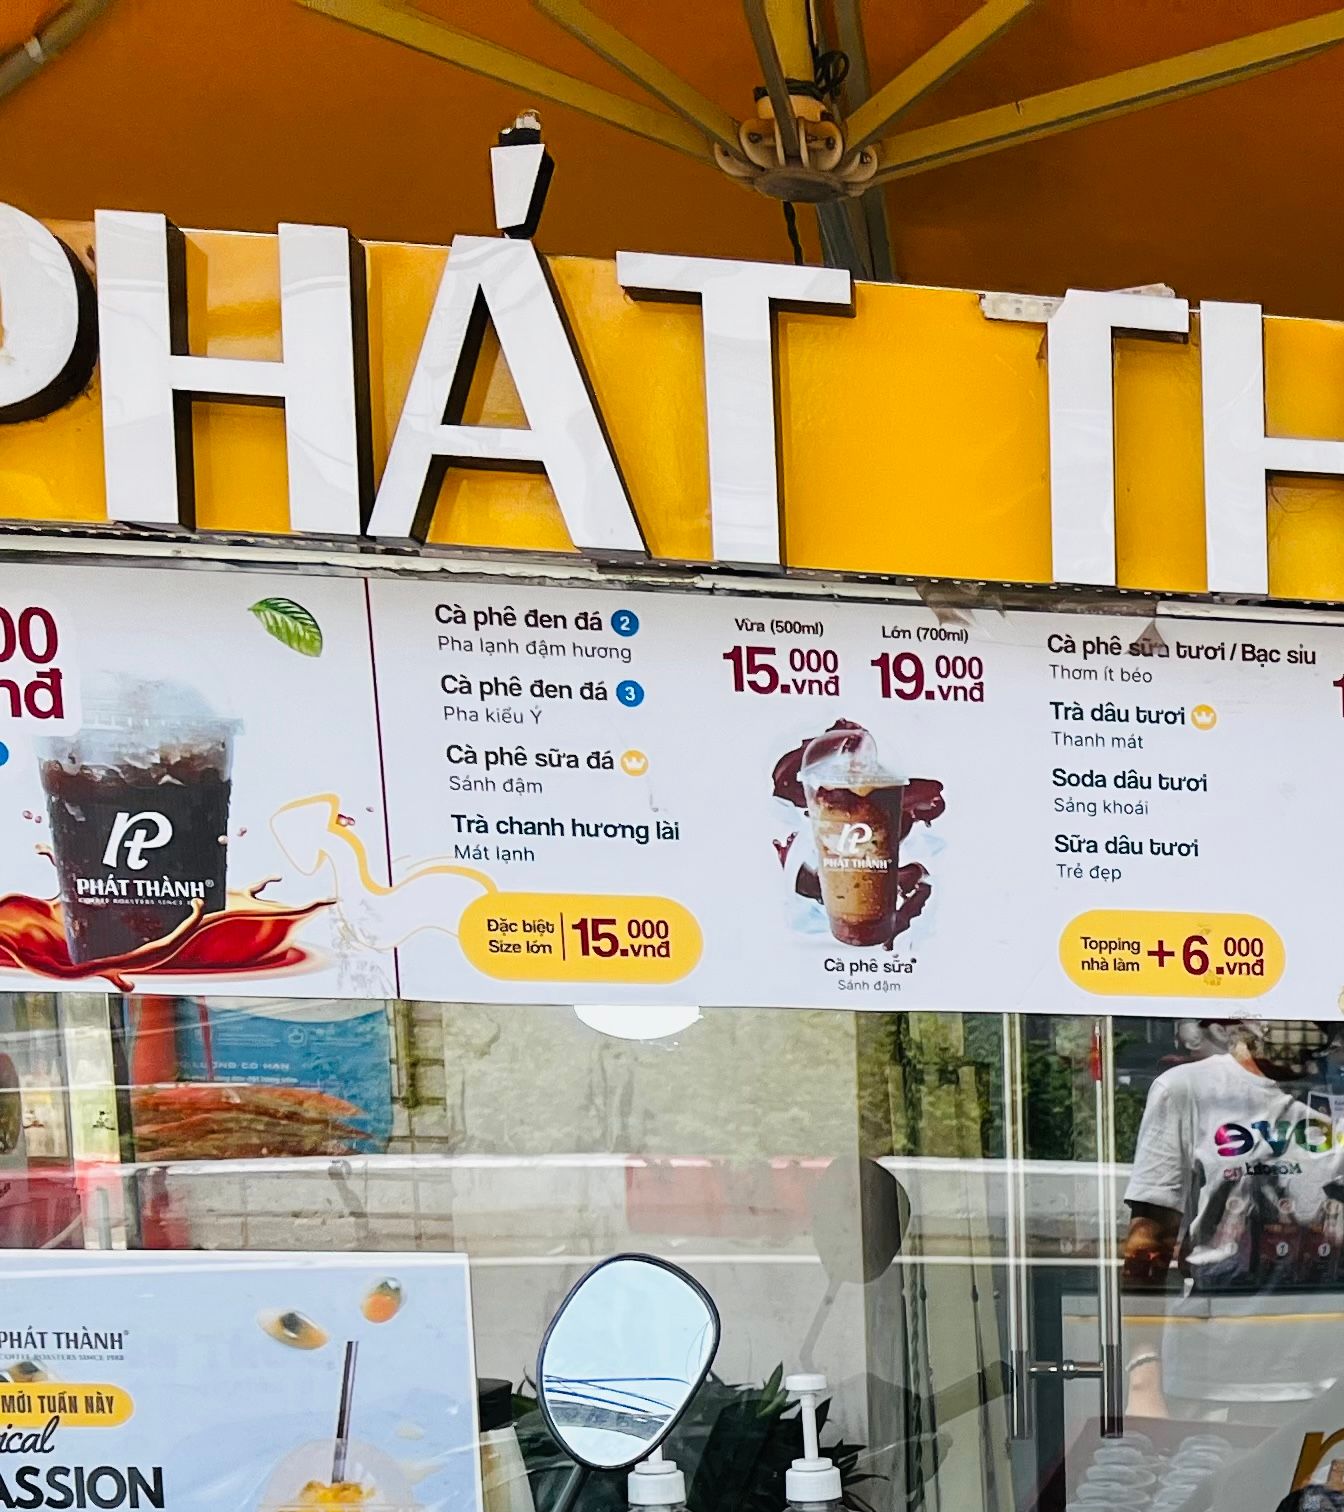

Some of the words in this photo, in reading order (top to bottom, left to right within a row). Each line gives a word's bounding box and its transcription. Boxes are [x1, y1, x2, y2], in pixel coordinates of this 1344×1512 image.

[434, 603, 467, 627] Cà
[472, 605, 518, 631] phê
[524, 609, 568, 631] đen
[575, 610, 603, 633] đá
[734, 617, 764, 633] Vừa
[770, 619, 824, 637] (500ml)
[881, 624, 910, 641] Lớn
[916, 625, 969, 644] (700ml)
[438, 636, 471, 655] Pha
[477, 636, 519, 661] lạnh
[524, 639, 566, 663] đậm
[571, 642, 633, 664] hương
[788, 649, 839, 674] 000
[1046, 632, 1079, 656] Cà
[1083, 635, 1122, 661] phê
[1175, 639, 1226, 662] tươi
[1241, 643, 1281, 668] Bạc
[1286, 645, 1317, 666] siu
[791, 674, 840, 698] vnđ
[1049, 664, 1101, 684] Thơm
[1105, 664, 1116, 684] ít
[1119, 665, 1153, 685] béo
[1050, 700, 1085, 722] Trà
[1090, 702, 1131, 724] dâu
[1136, 705, 1187, 726] tươi
[1051, 731, 1107, 749] Thanh
[1111, 732, 1144, 750] mát
[446, 743, 479, 767] Cà
[484, 745, 529, 771] phê
[535, 747, 581, 771] sữa
[586, 750, 615, 772] đá
[448, 774, 496, 794] Sánh
[502, 776, 544, 799] đậm
[1051, 768, 1108, 790] Soda
[1113, 769, 1153, 792] dâu
[1158, 771, 1208, 793] tươi
[1053, 795, 1098, 818] Sảng
[1103, 798, 1149, 817] khoái
[451, 812, 490, 835] Trà
[496, 815, 565, 839] chanh
[571, 818, 650, 846] hương
[655, 819, 680, 841] lài
[454, 841, 488, 862] Mát
[493, 843, 536, 868] lạnh
[1054, 832, 1100, 856] Sữa
[1105, 836, 1145, 858] dâu
[1150, 837, 1200, 858] tươi
[76, 873, 130, 896] PHÁT
[1056, 861, 1083, 880] Trẻ
[1088, 862, 1122, 885] đẹp
[486, 916, 519, 938] Đặc
[524, 916, 555, 938] biệt
[627, 918, 669, 939] 000
[488, 937, 520, 955] Size
[525, 937, 553, 956] lớn
[629, 938, 671, 959] vnđ
[1080, 936, 1141, 955] Topping
[1224, 937, 1264, 959] 000
[1081, 955, 1109, 972] nhà
[1112, 956, 1140, 973] làm
[1225, 957, 1265, 977] vnđ
[84, 1391, 115, 1416] NÀY
